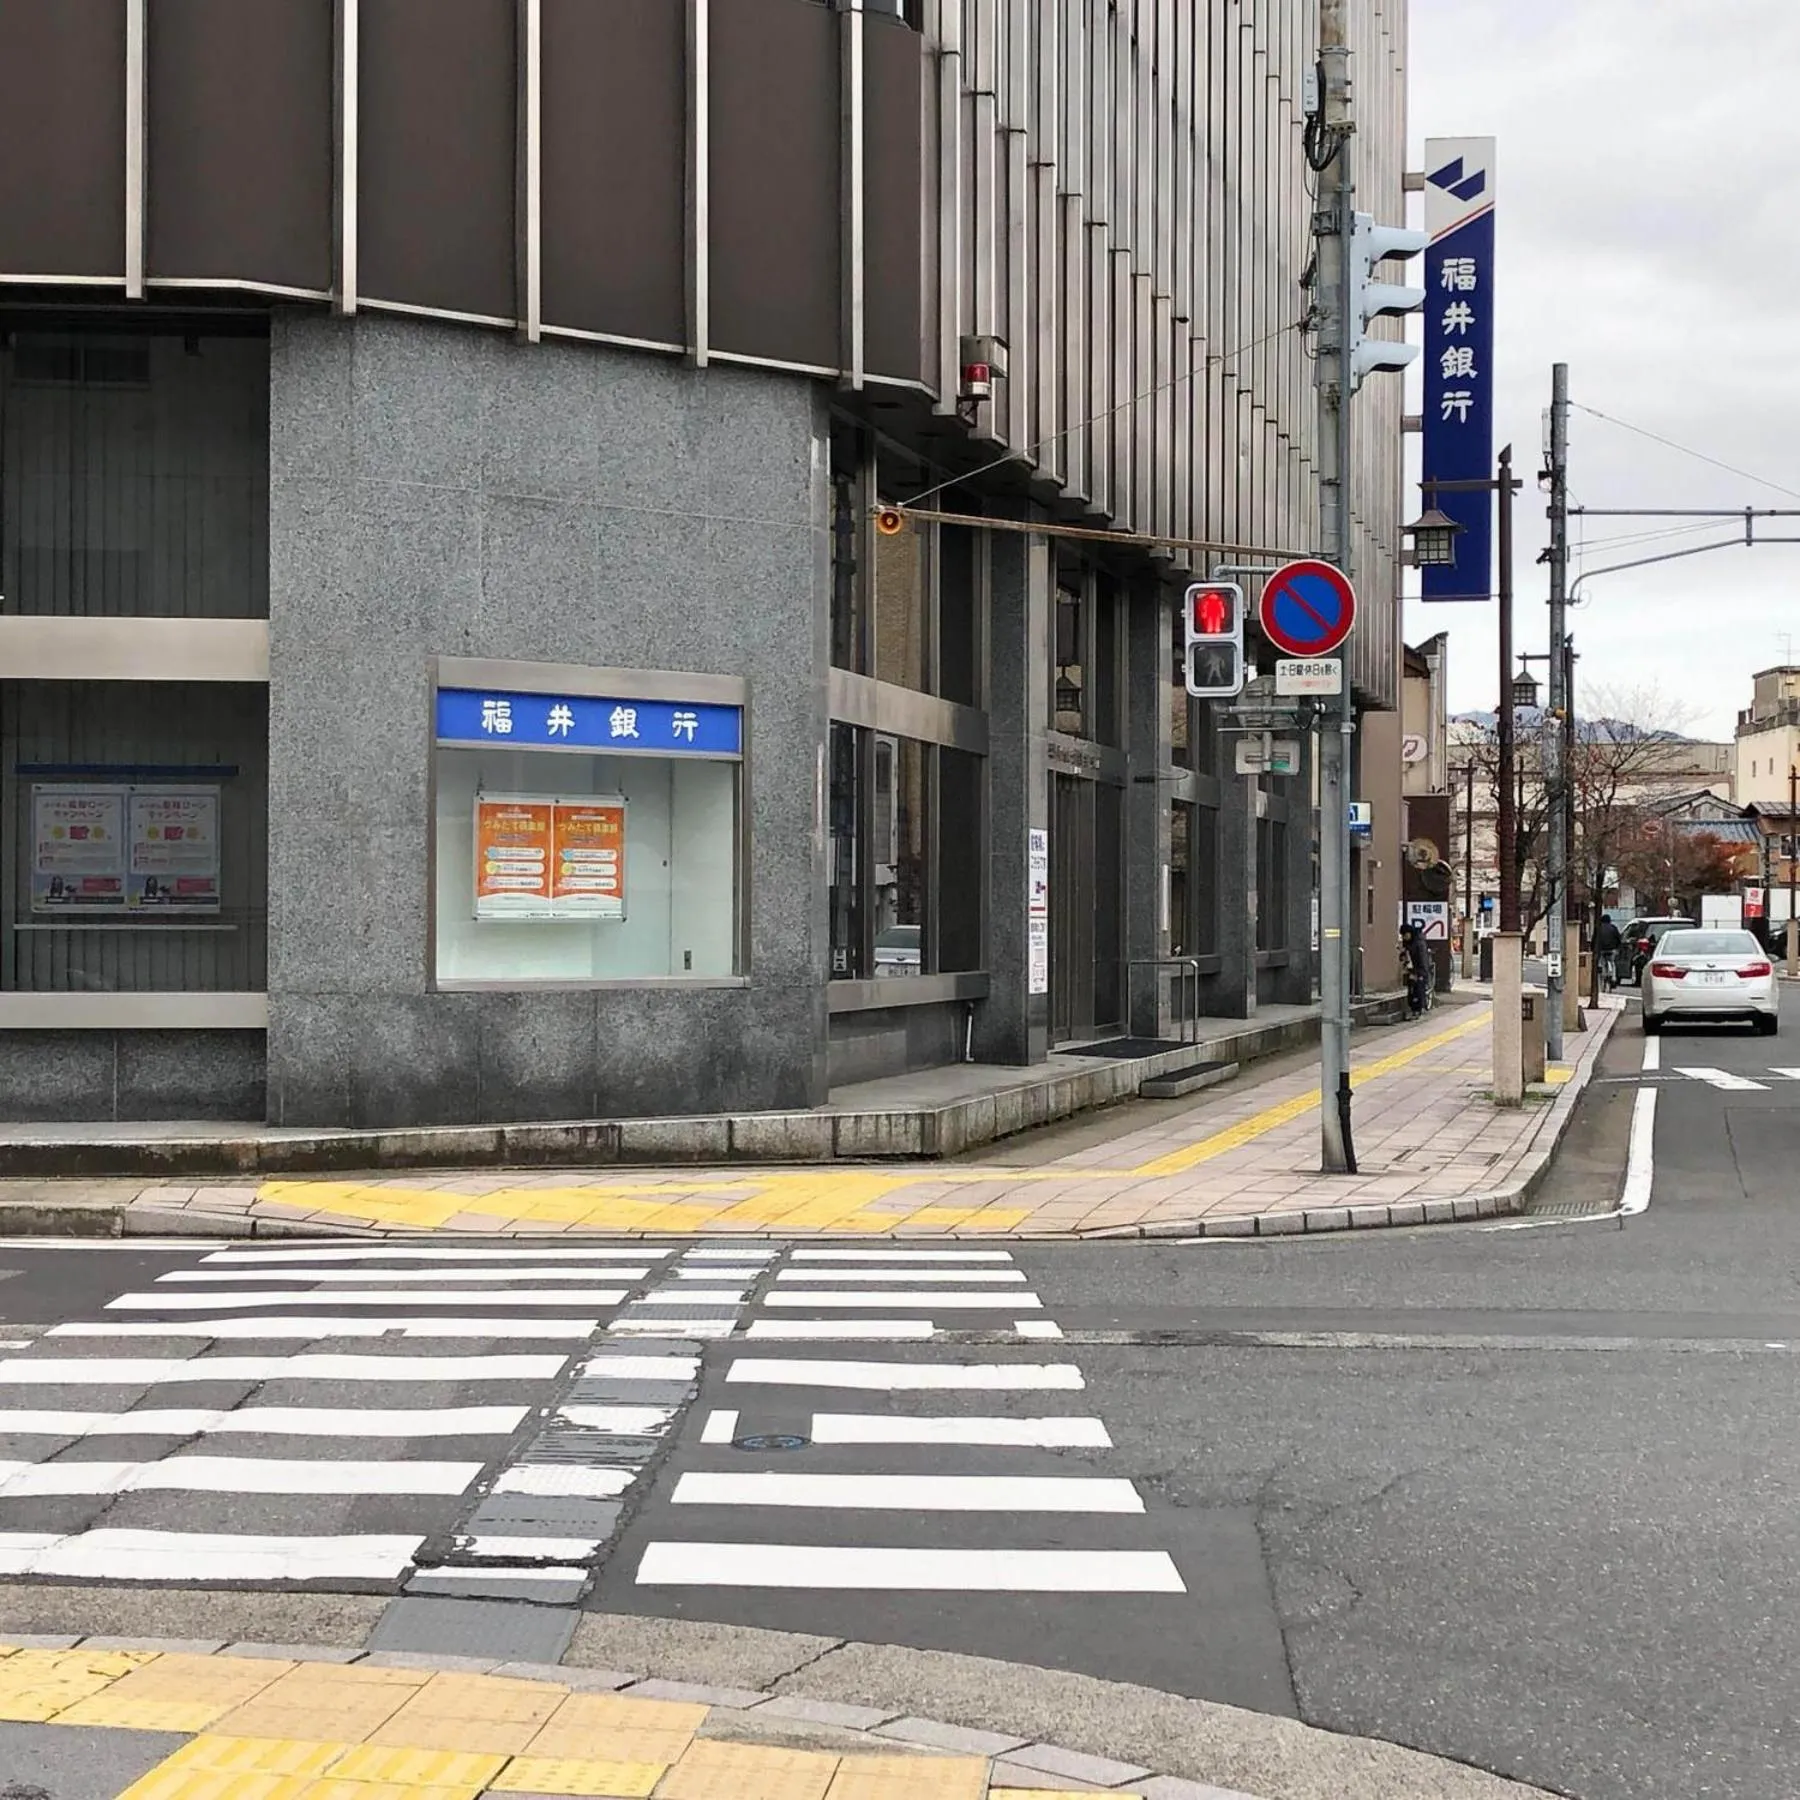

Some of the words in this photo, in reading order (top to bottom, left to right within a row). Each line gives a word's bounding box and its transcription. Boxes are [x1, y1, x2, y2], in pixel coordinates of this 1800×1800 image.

[1439, 256, 1479, 424] 福井銀行
[481, 700, 699, 742] 福井銀行
